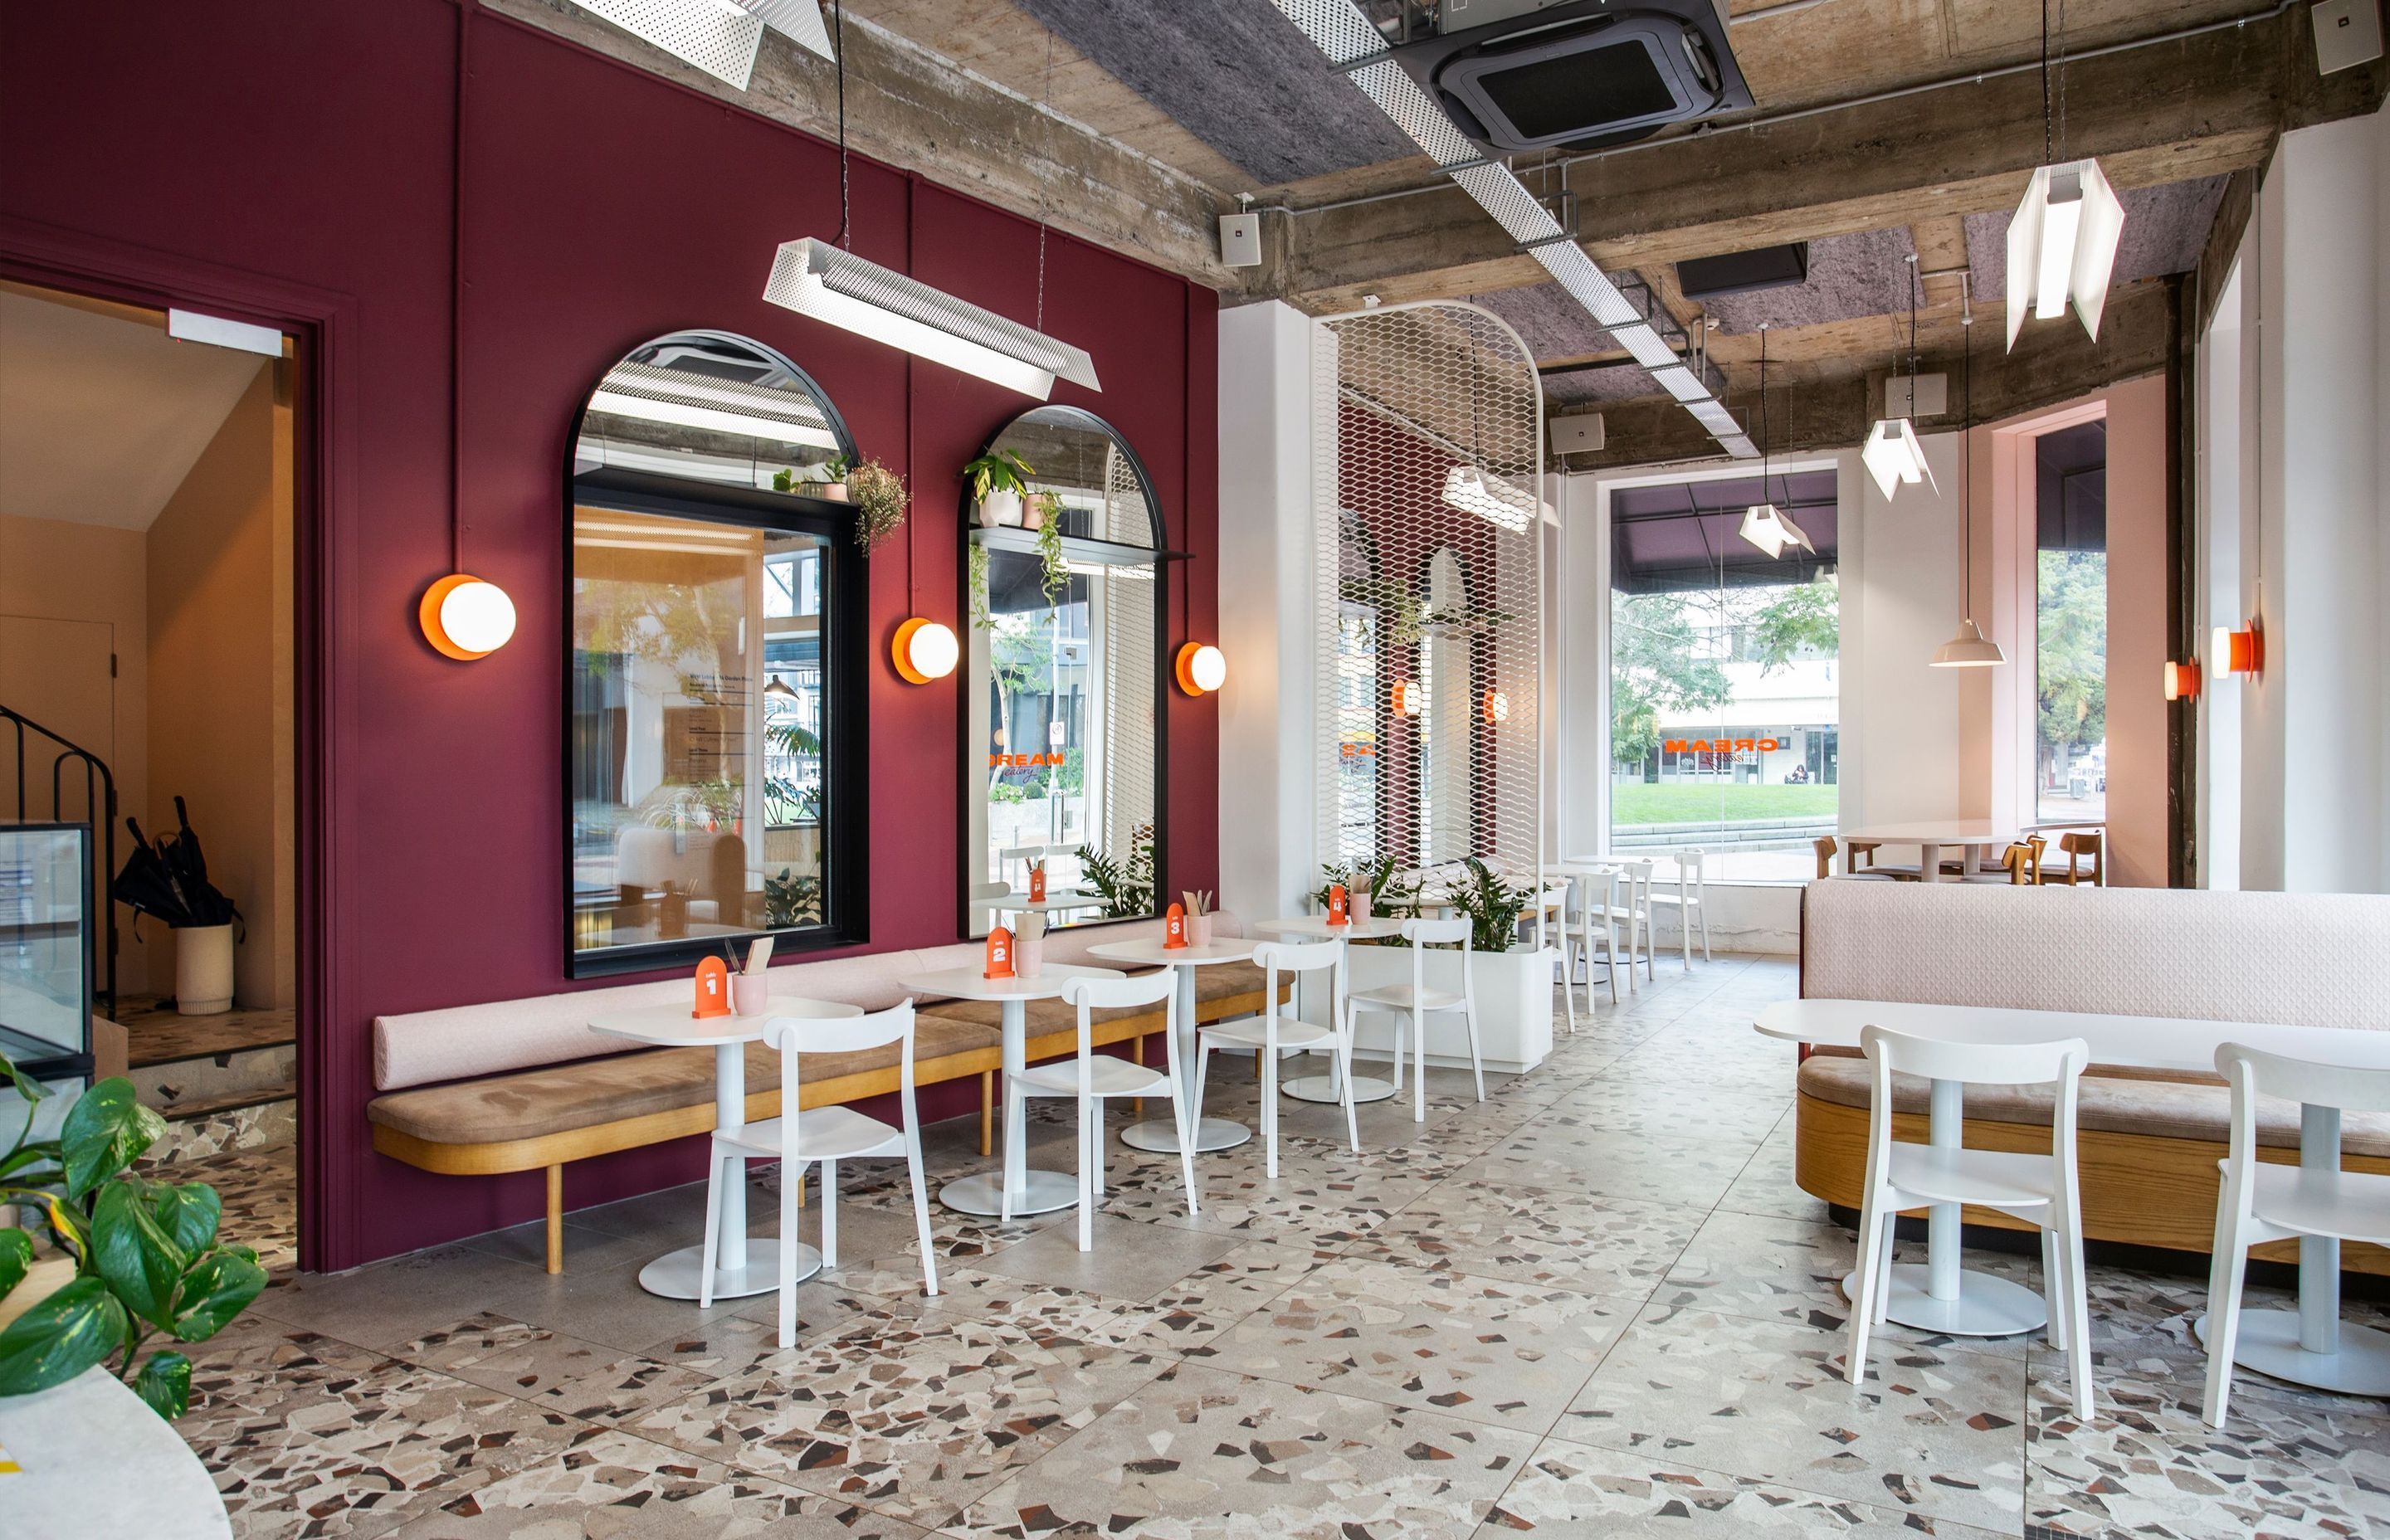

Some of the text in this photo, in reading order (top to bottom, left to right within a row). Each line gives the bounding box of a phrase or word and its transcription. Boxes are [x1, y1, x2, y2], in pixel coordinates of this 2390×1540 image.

[1005, 764, 1036, 784] eatery
[1333, 902, 1342, 912] 4
[993, 948, 1006, 962] 2
[706, 979, 716, 995] 1
